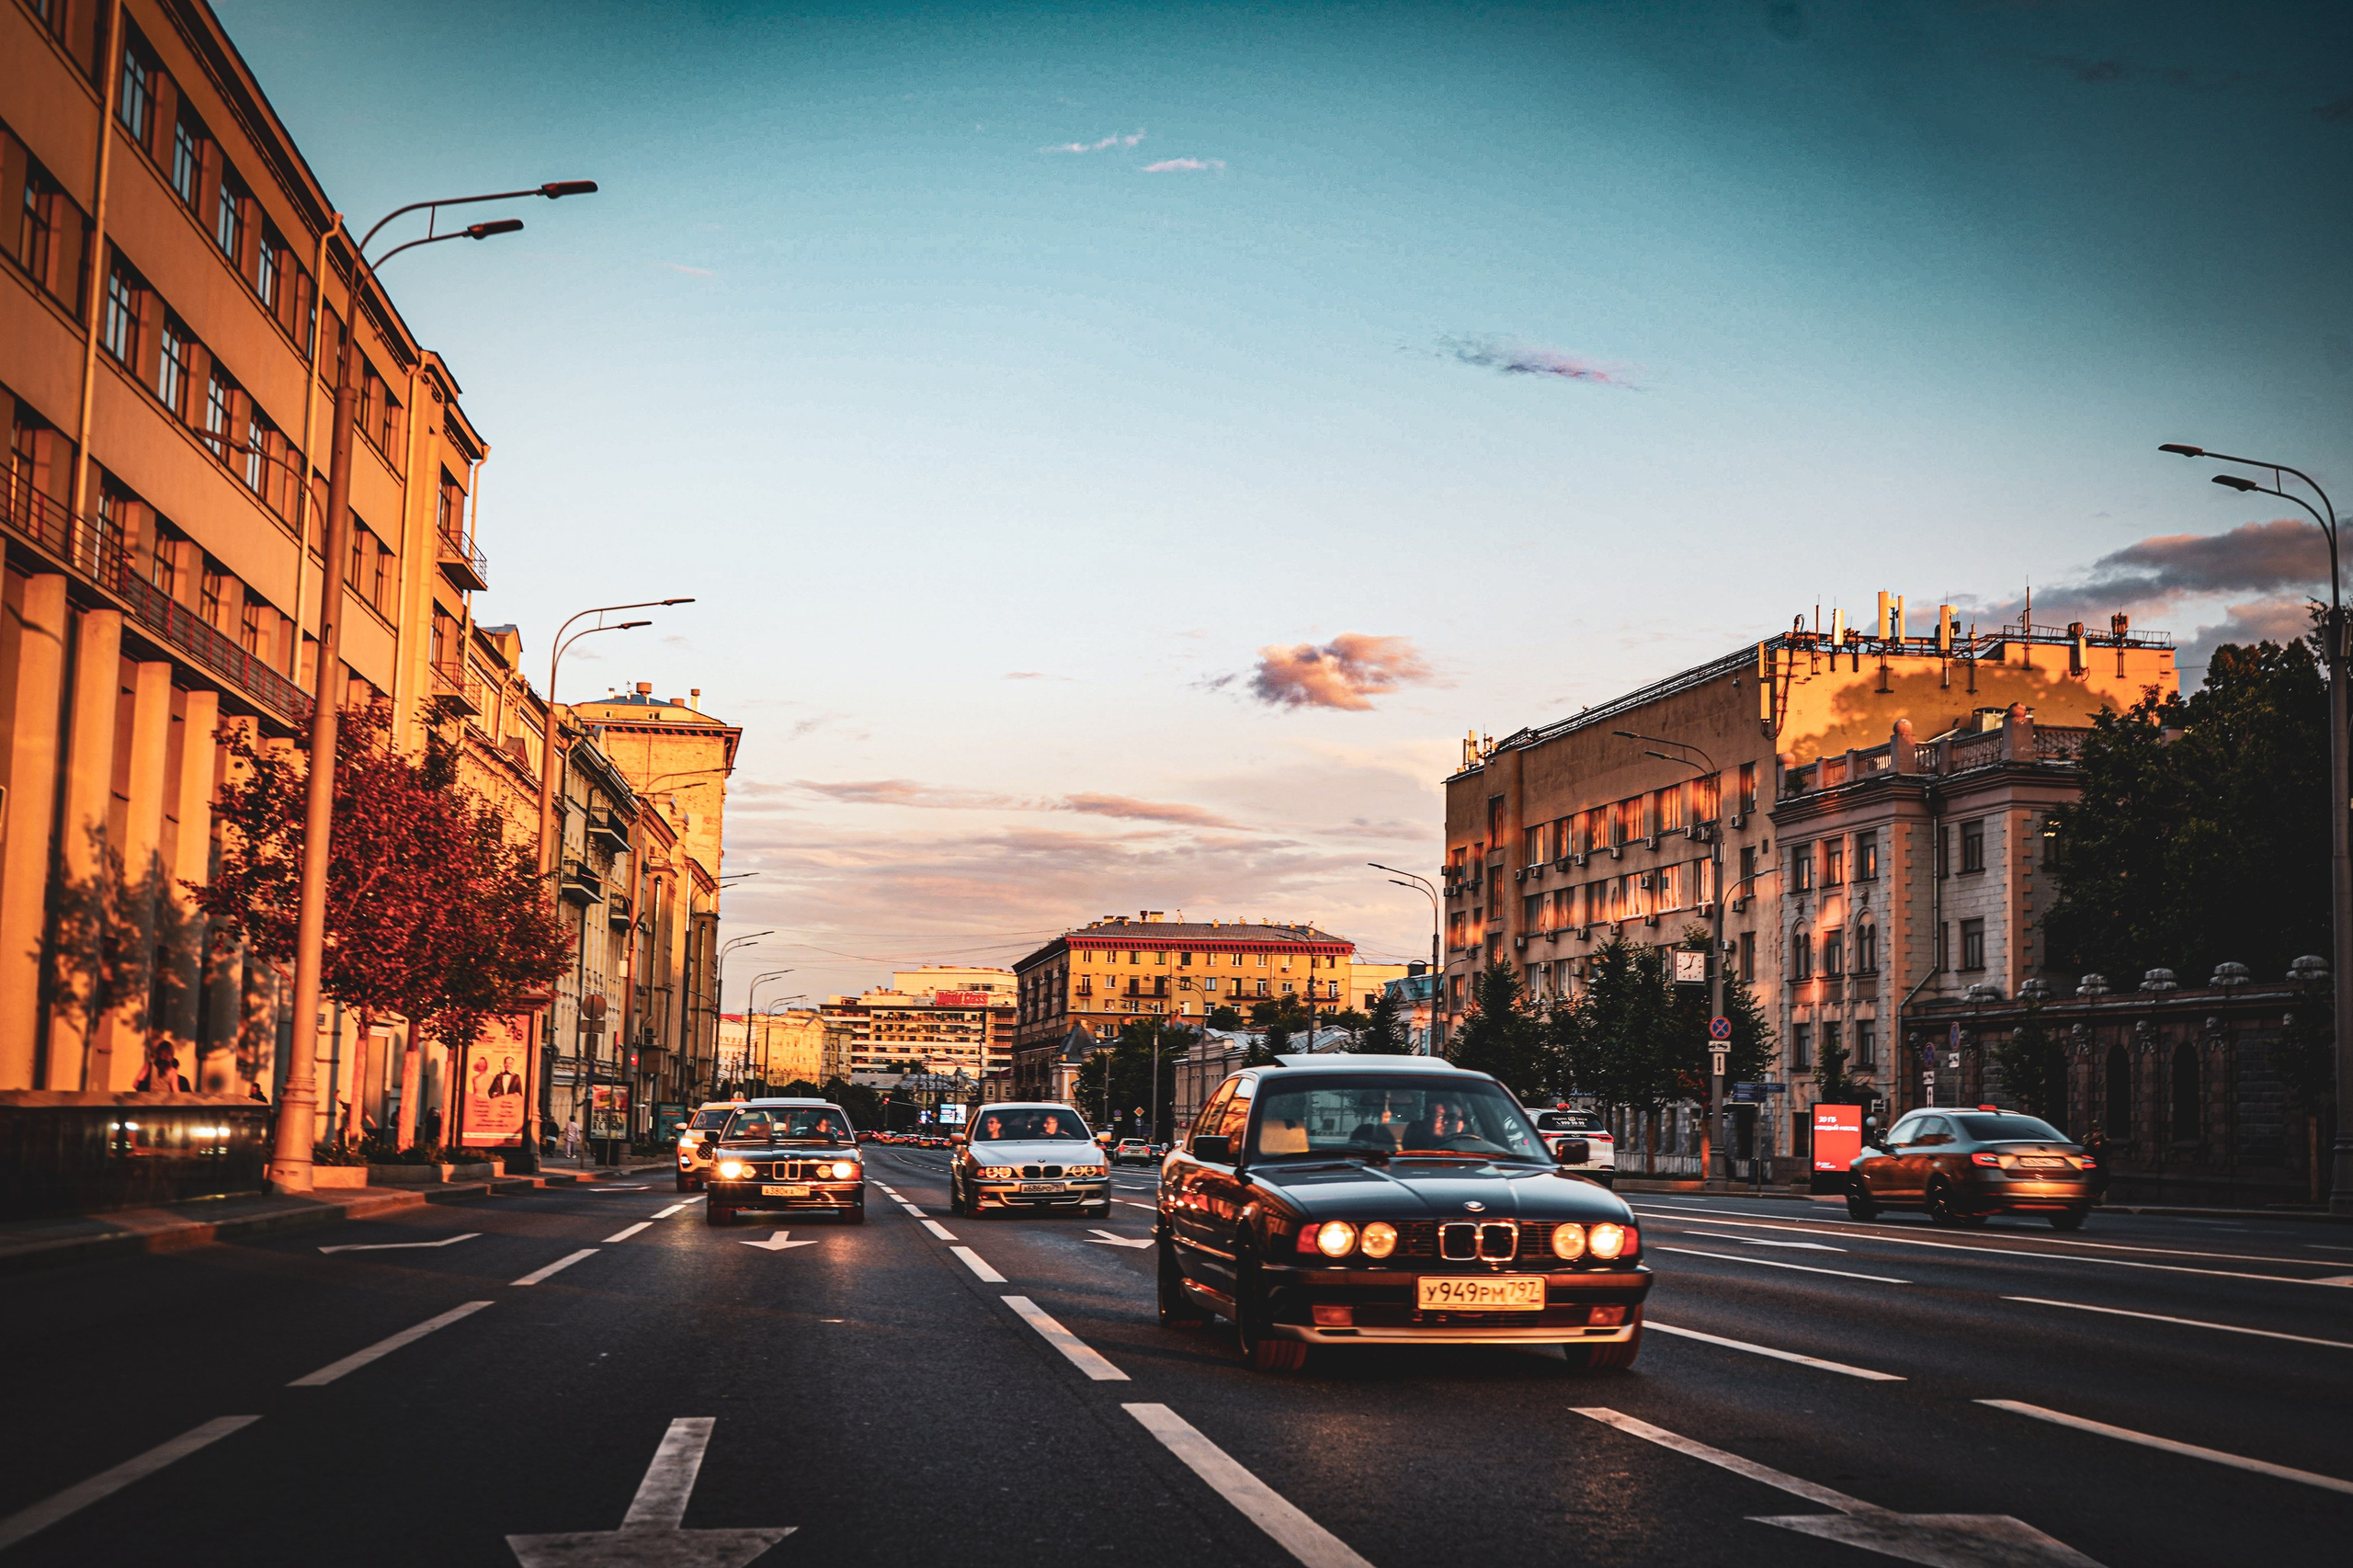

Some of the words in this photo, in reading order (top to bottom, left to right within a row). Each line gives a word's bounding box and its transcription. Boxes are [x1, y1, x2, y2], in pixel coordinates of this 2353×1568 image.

[937, 992, 962, 1006] World
[964, 992, 988, 1006] Class
[1507, 1281, 1536, 1297] 797
